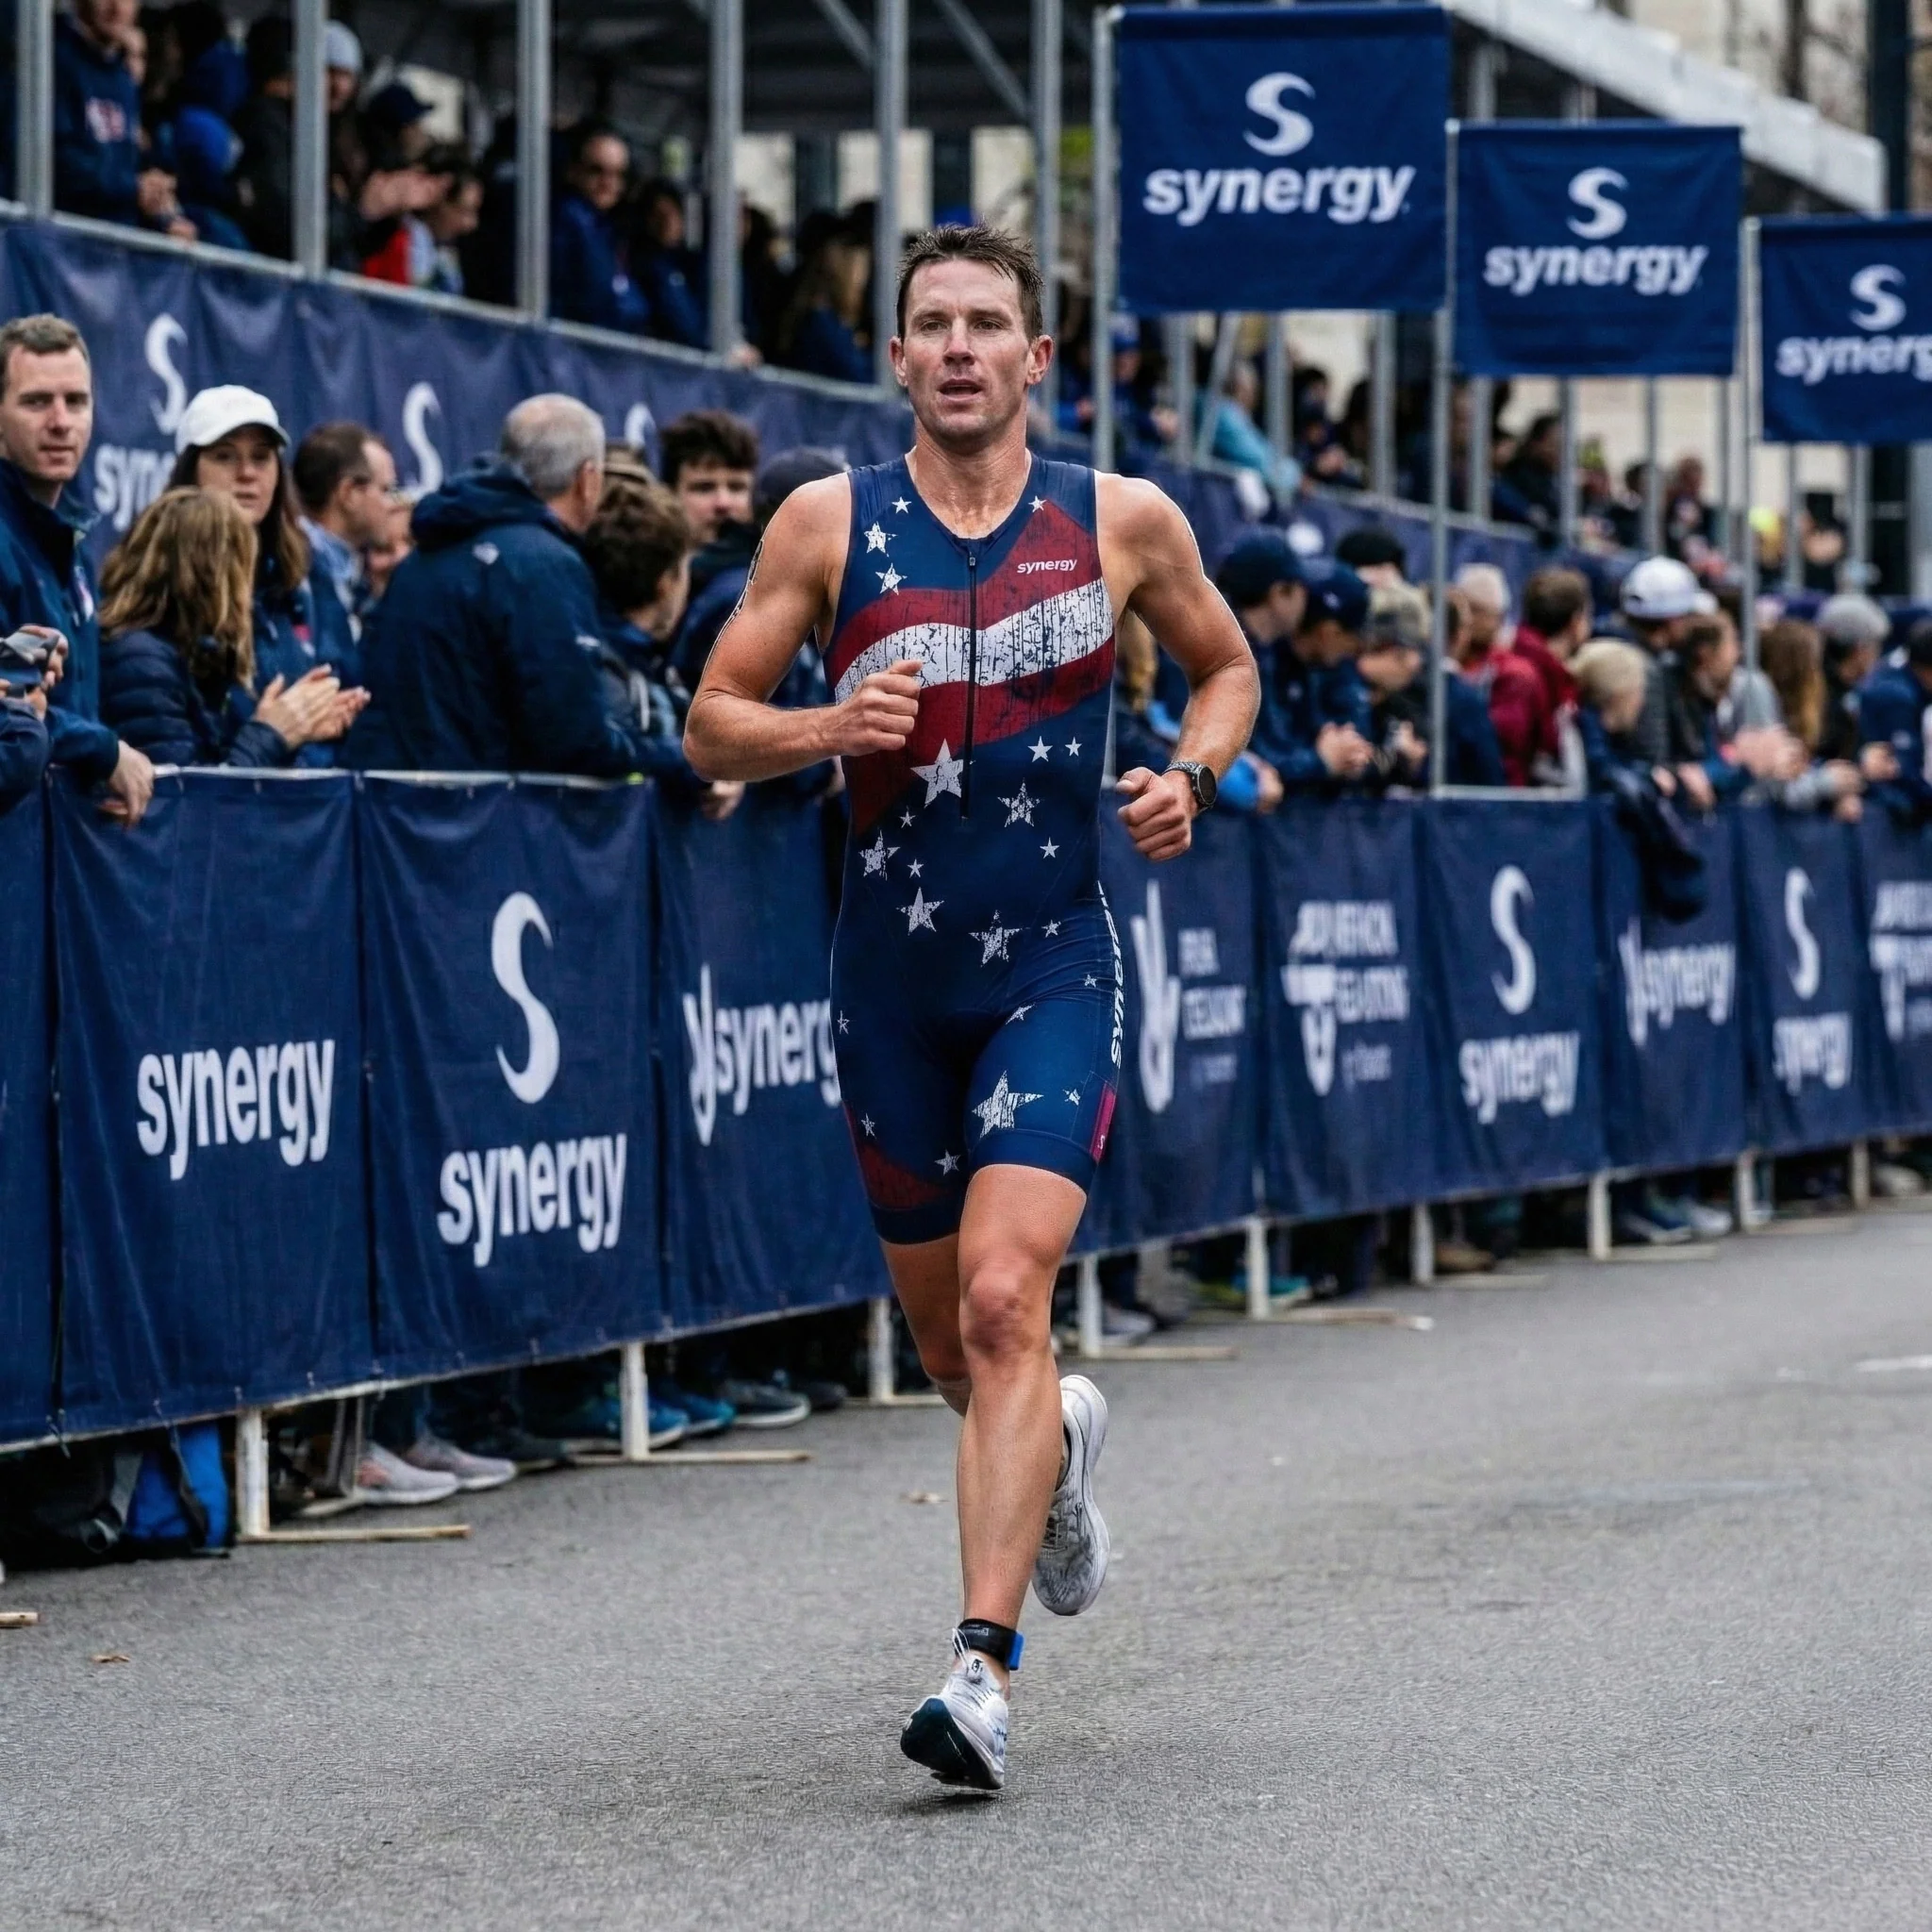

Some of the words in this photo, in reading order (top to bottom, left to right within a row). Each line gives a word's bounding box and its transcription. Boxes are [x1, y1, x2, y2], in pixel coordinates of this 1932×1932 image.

[1144, 165, 1415, 226] synergy
[1484, 244, 1708, 295] synergy
[1016, 558, 1078, 575] synergy
[136, 1039, 336, 1181] synergy
[1458, 1032, 1580, 1124] synergy
[437, 1132, 627, 1268] synergy
